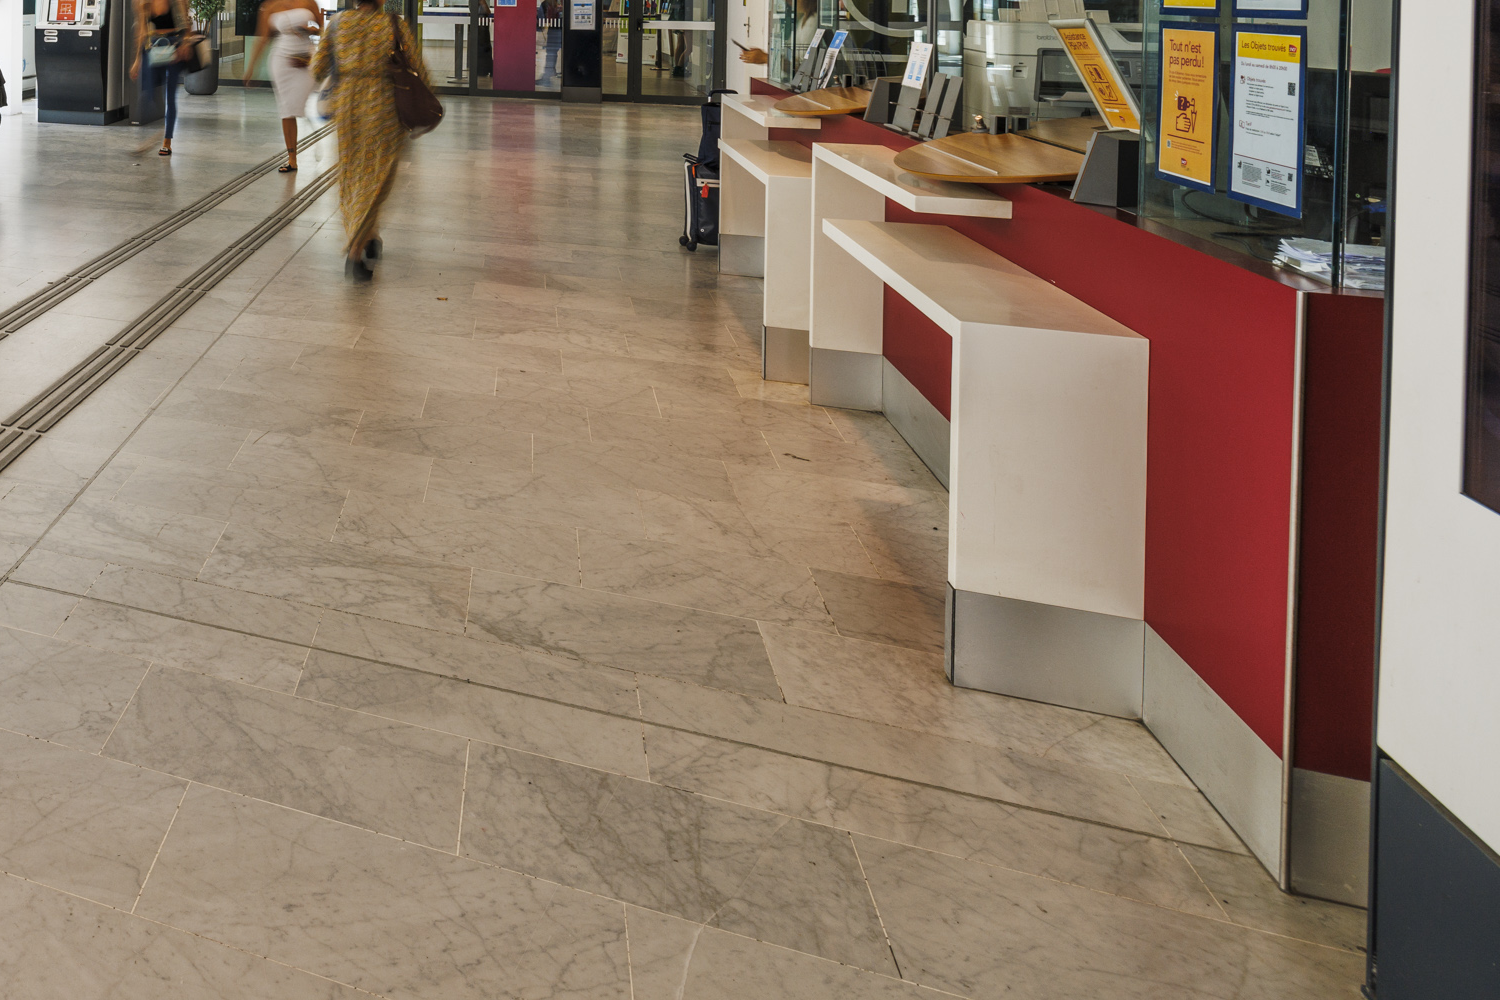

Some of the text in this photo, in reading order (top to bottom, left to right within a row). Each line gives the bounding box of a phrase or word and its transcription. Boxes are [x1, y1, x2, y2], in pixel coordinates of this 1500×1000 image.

[1170, 39, 1201, 54] Tout n'est
[1251, 41, 1266, 51] Objets
[1268, 44, 1286, 52] trouvés
[1170, 56, 1179, 68] pas
